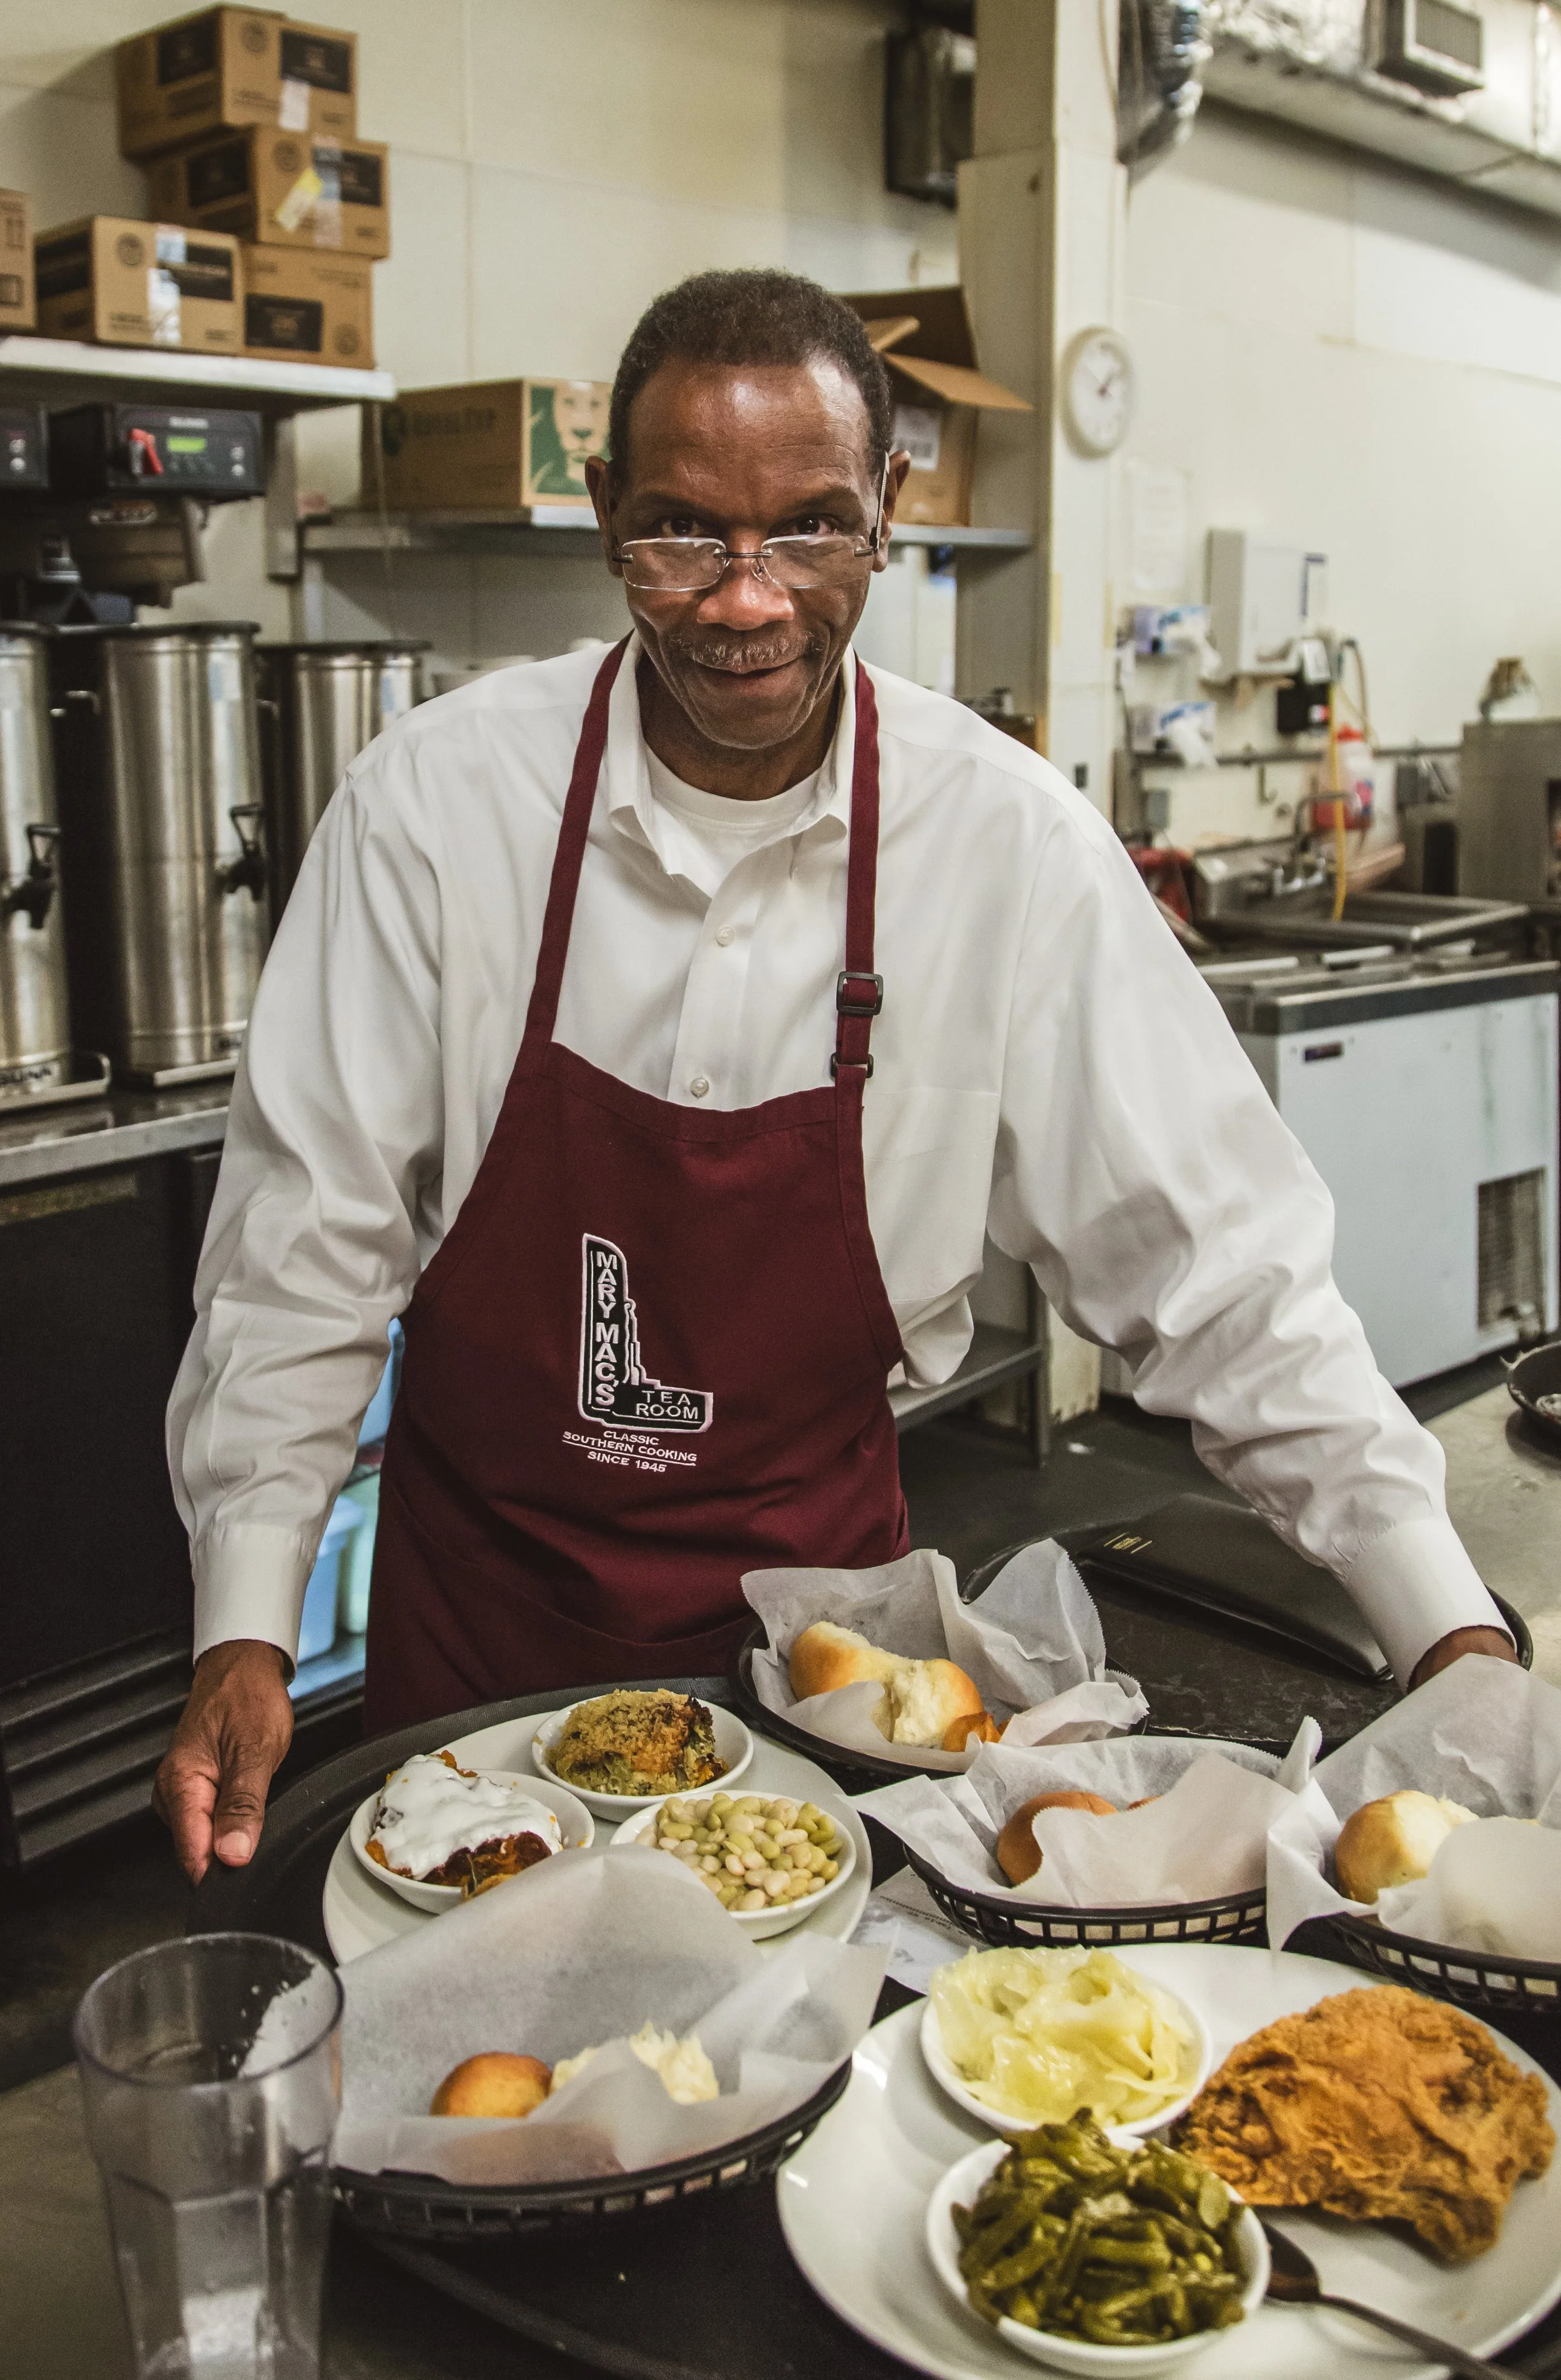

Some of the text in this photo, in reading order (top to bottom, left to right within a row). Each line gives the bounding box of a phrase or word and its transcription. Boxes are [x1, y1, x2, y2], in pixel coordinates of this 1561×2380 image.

[594, 1251, 619, 1406] MARY MAC'S
[642, 1390, 691, 1405] TEA
[636, 1403, 698, 1419] ROOM
[563, 1431, 697, 1461] SOUTHERN COOKING
[603, 1431, 659, 1445] CLASSIC
[588, 1451, 667, 1473] SINCE 1945
